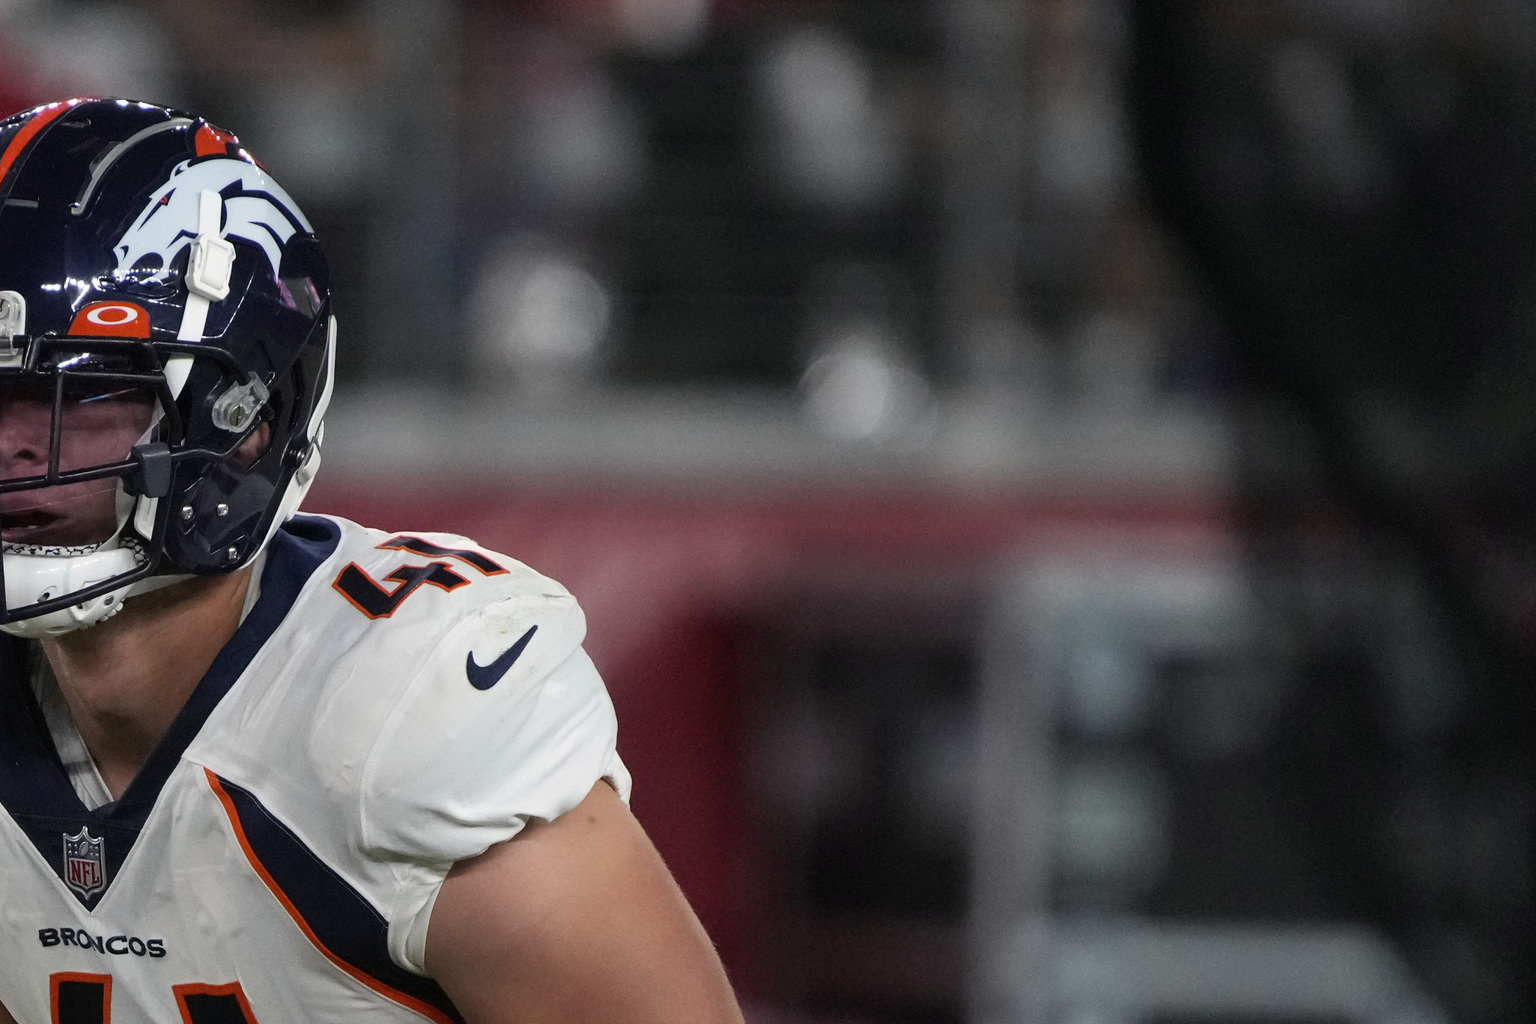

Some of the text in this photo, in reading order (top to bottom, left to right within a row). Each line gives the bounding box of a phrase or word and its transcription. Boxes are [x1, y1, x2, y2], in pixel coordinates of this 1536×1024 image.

[331, 535, 511, 620] 41
[70, 859, 100, 886] NFL
[38, 927, 167, 958] BRONCOS
